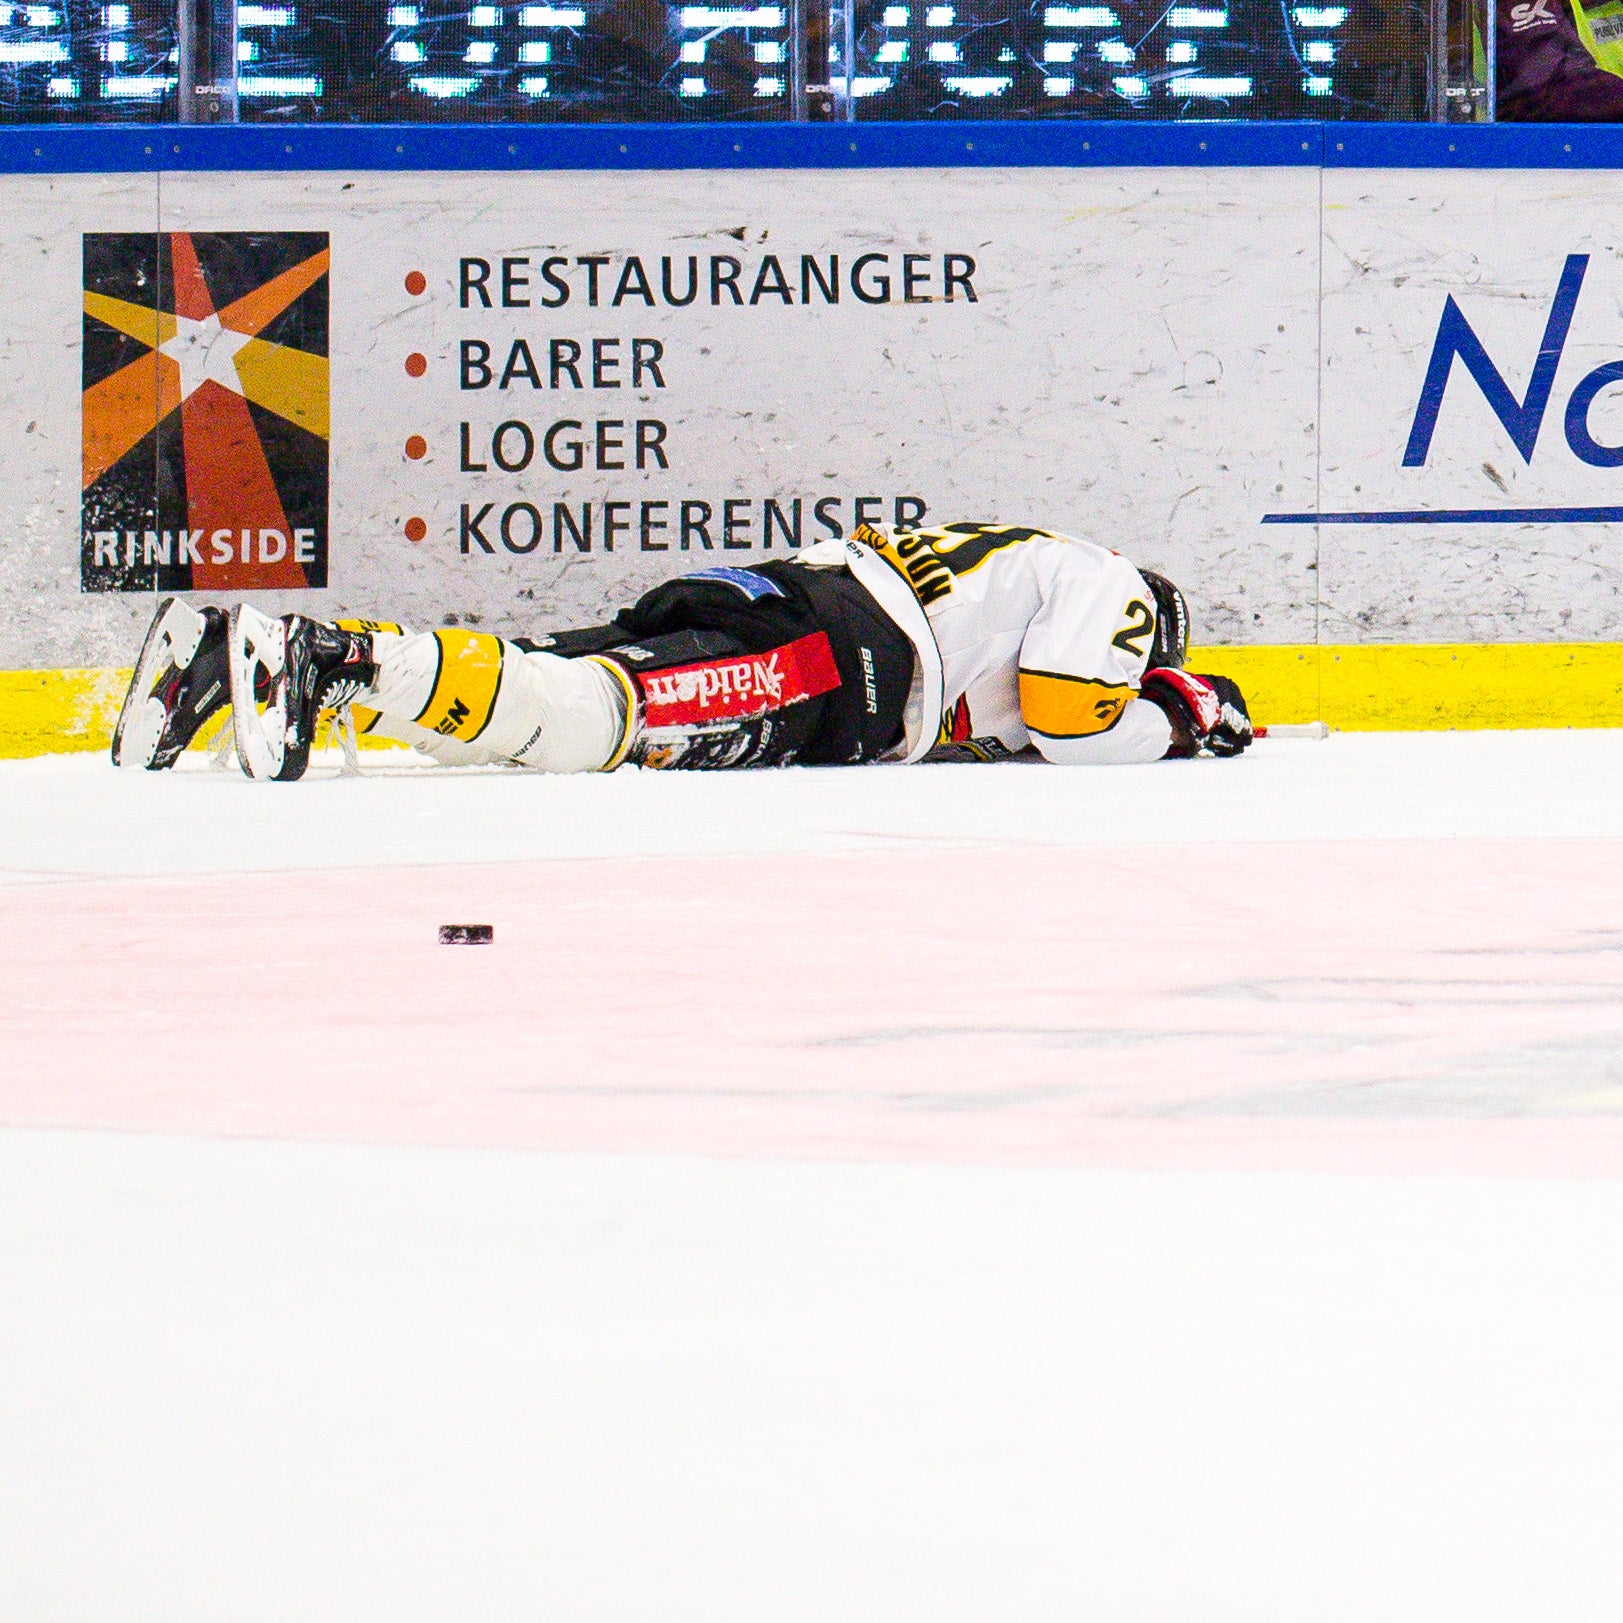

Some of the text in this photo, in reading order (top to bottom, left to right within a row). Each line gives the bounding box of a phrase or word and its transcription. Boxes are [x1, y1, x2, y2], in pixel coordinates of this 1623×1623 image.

[459, 253, 978, 308] RESTAURANGER
[459, 338, 665, 389] BARER
[459, 420, 669, 472] LOGER
[92, 529, 317, 565] RINKSIDE
[459, 496, 928, 555] KONFERENSER
[860, 646, 879, 714] BAUER
